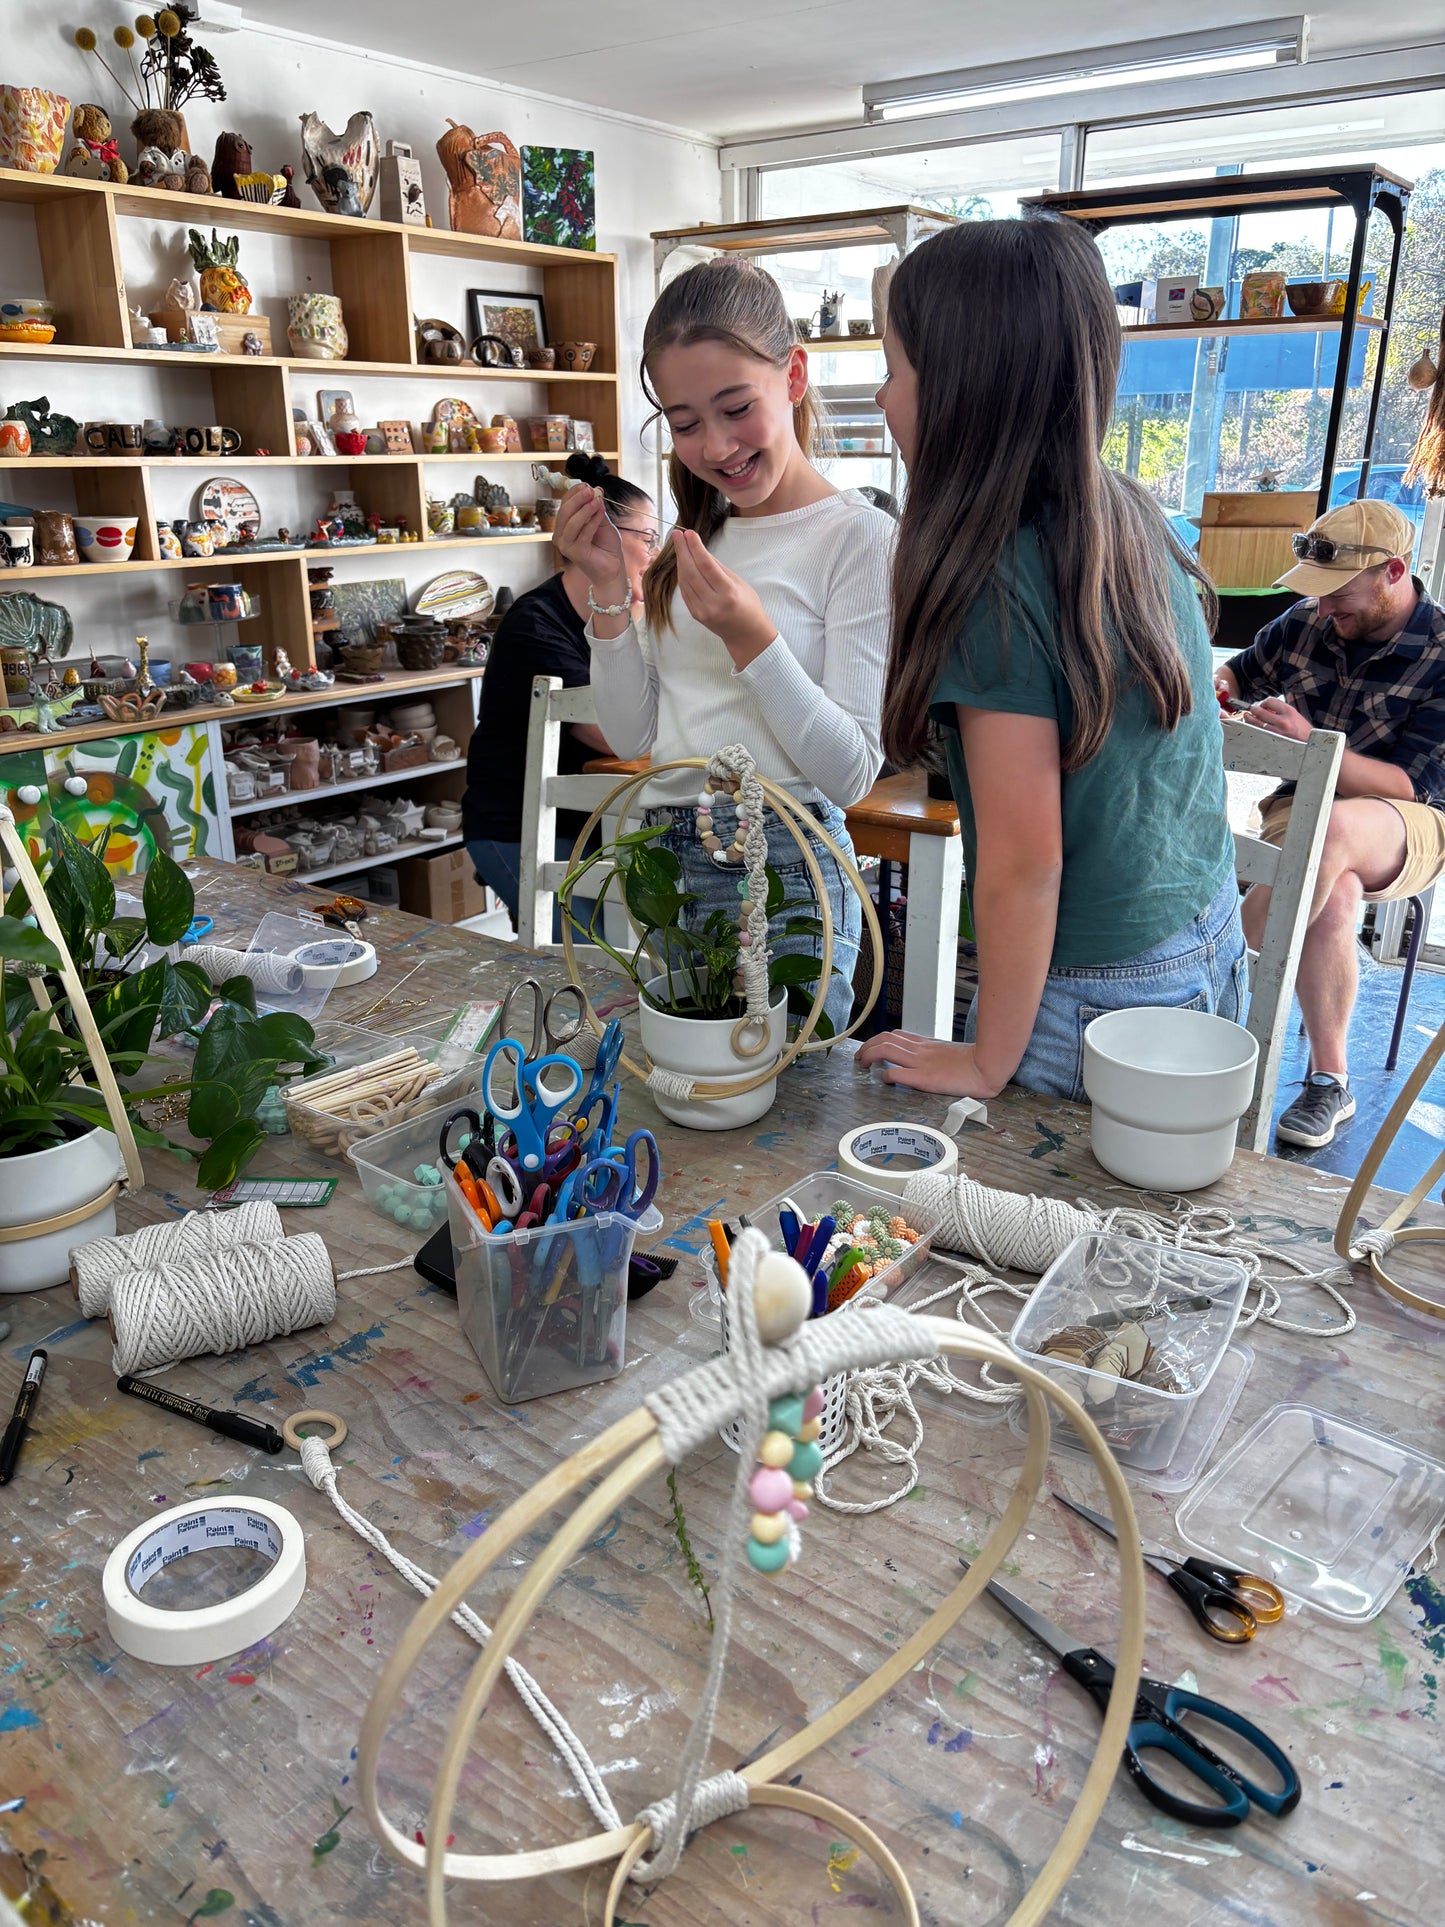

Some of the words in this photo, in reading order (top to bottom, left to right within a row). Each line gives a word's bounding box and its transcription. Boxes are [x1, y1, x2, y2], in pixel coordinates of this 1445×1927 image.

[177, 1518, 199, 1529] Paint
[177, 1524, 199, 1535] Partner
[206, 1525, 228, 1533] Paint
[206, 1531, 228, 1539] Partner
[234, 1537, 253, 1546] Paint
[163, 1548, 182, 1562] Paint
